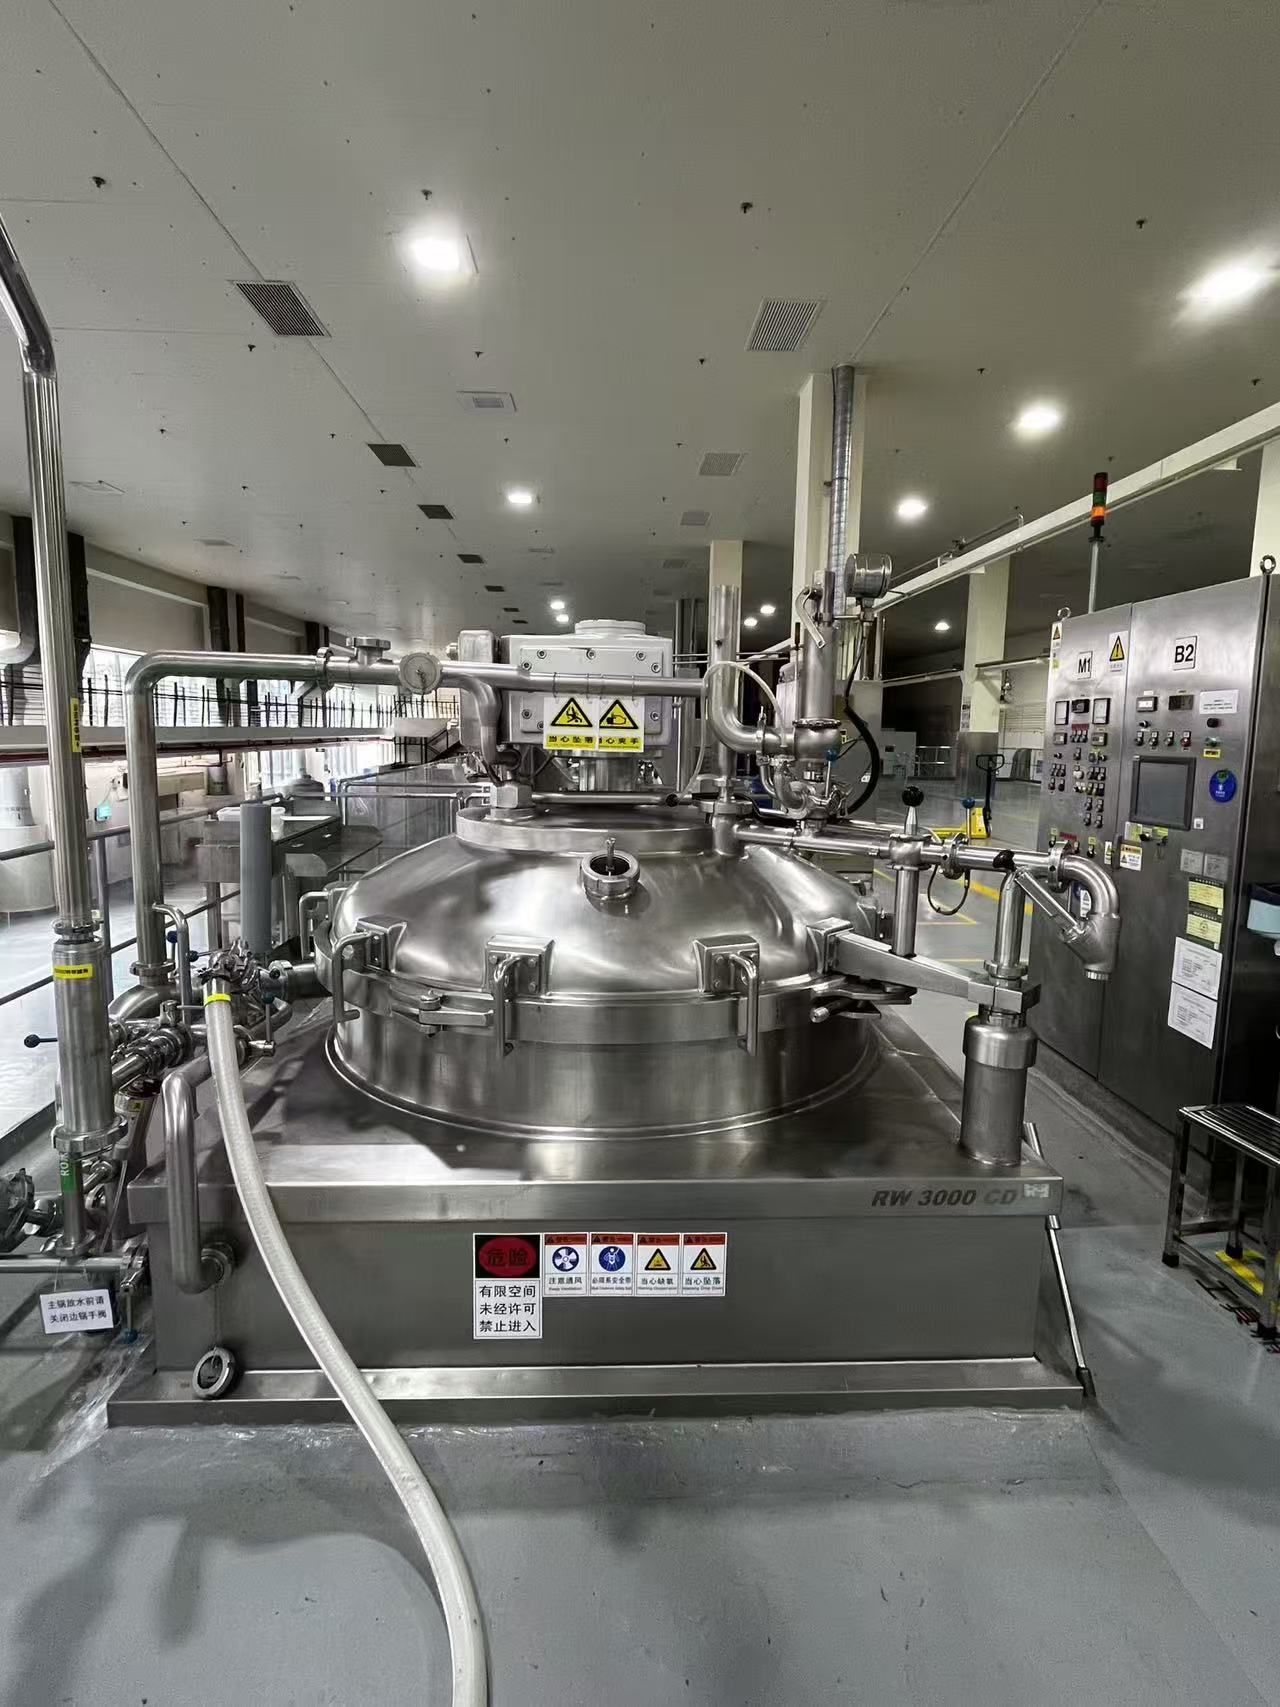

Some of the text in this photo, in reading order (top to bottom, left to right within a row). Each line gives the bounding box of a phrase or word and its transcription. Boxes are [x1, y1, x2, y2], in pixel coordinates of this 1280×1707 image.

[1174, 644, 1195, 664] B2
[1077, 658, 1091, 674] M1
[872, 1189, 913, 1207] RW
[917, 1189, 977, 1207] 3000
[984, 1189, 1017, 1205] CD
[548, 1277, 582, 1285] 注意通风
[684, 1277, 721, 1286] 当心坠落
[479, 1285, 536, 1298] 有限空间
[479, 1302, 537, 1316] 未经许可
[479, 1319, 537, 1333] 禁止进入
